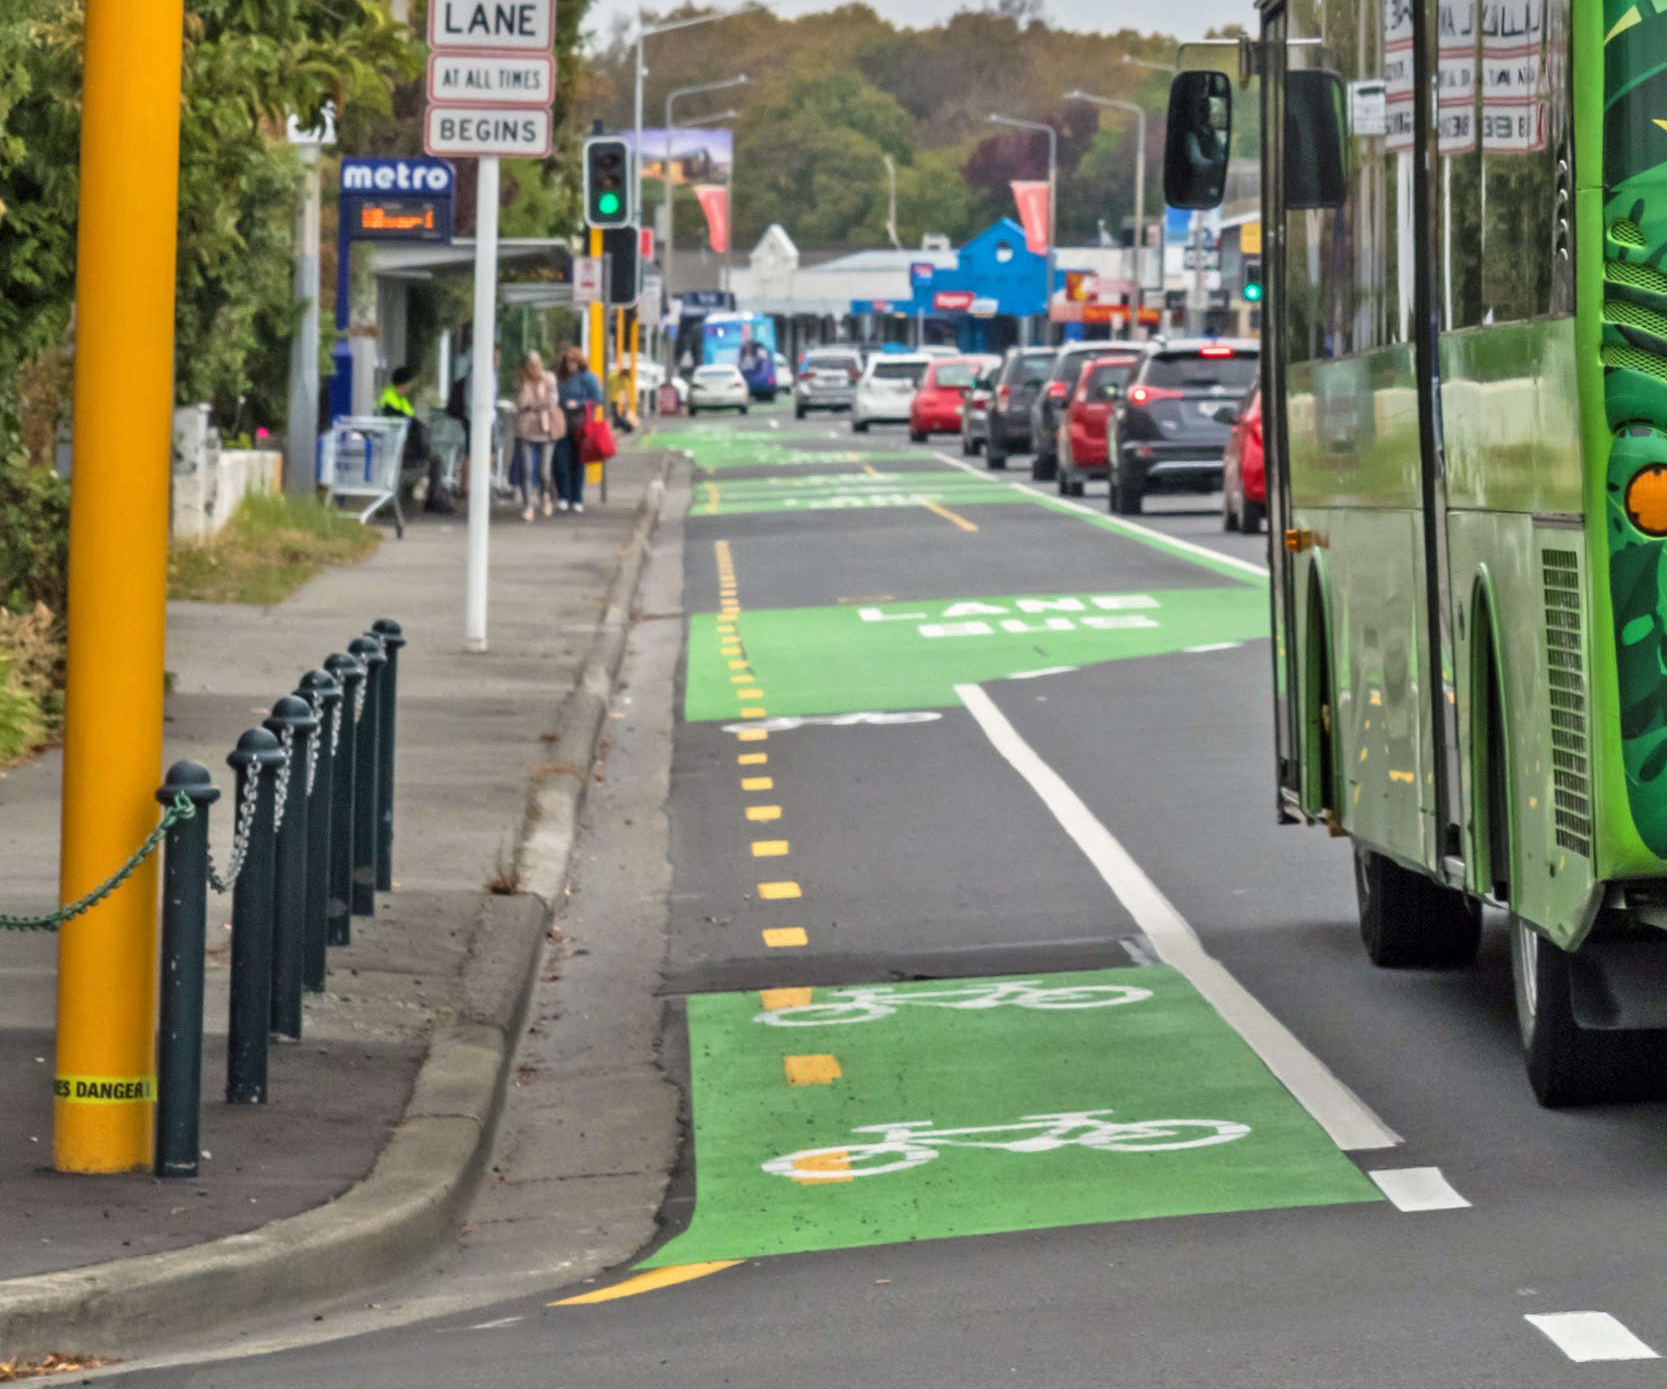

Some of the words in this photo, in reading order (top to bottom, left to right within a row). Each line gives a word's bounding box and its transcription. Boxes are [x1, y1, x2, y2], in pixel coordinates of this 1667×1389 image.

[445, 3, 537, 36] LANE
[442, 70, 460, 88] AT
[465, 70, 492, 89] ALL
[499, 70, 540, 91] TIMES
[440, 119, 537, 142] BEGINS
[343, 162, 449, 190] metro
[857, 594, 1161, 622] LANE
